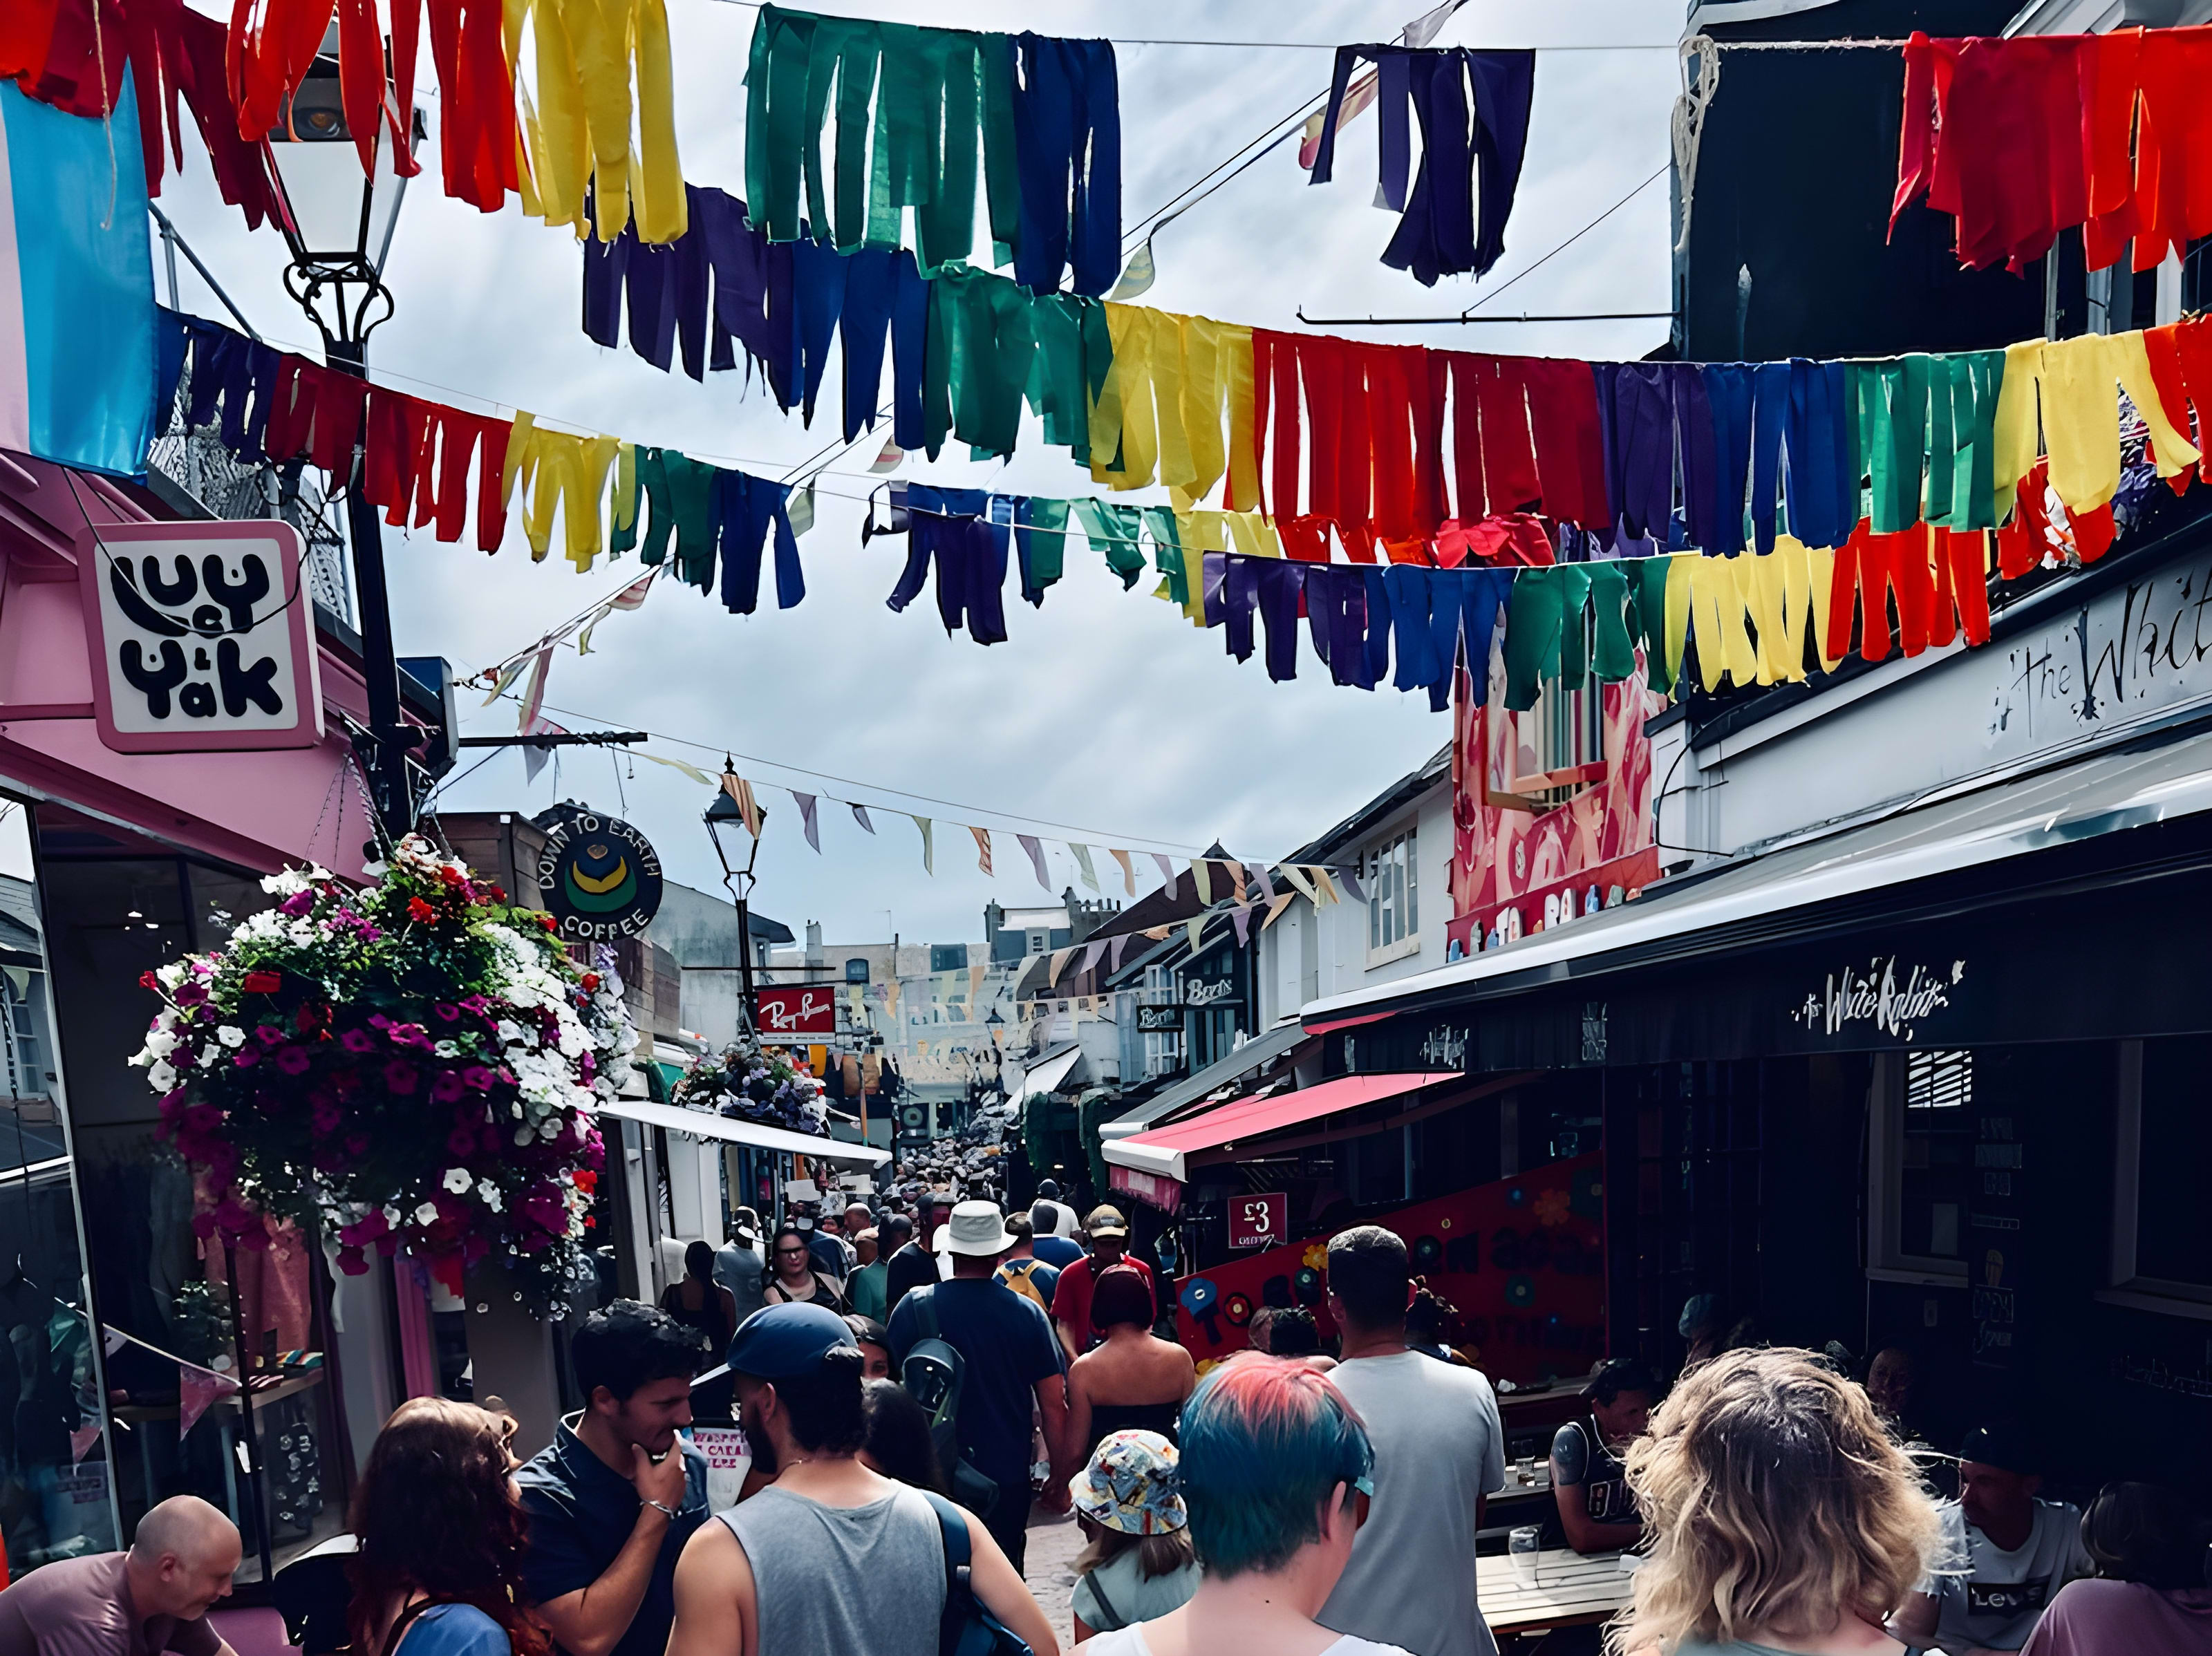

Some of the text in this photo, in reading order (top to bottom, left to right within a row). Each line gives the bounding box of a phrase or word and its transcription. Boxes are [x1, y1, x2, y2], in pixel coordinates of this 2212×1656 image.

[120, 638, 283, 719] Yak
[2010, 637, 2071, 738] the
[538, 813, 662, 890] DOWN TO EARTH
[564, 908, 649, 940] COFFEE
[1244, 1201, 1270, 1233] £3
